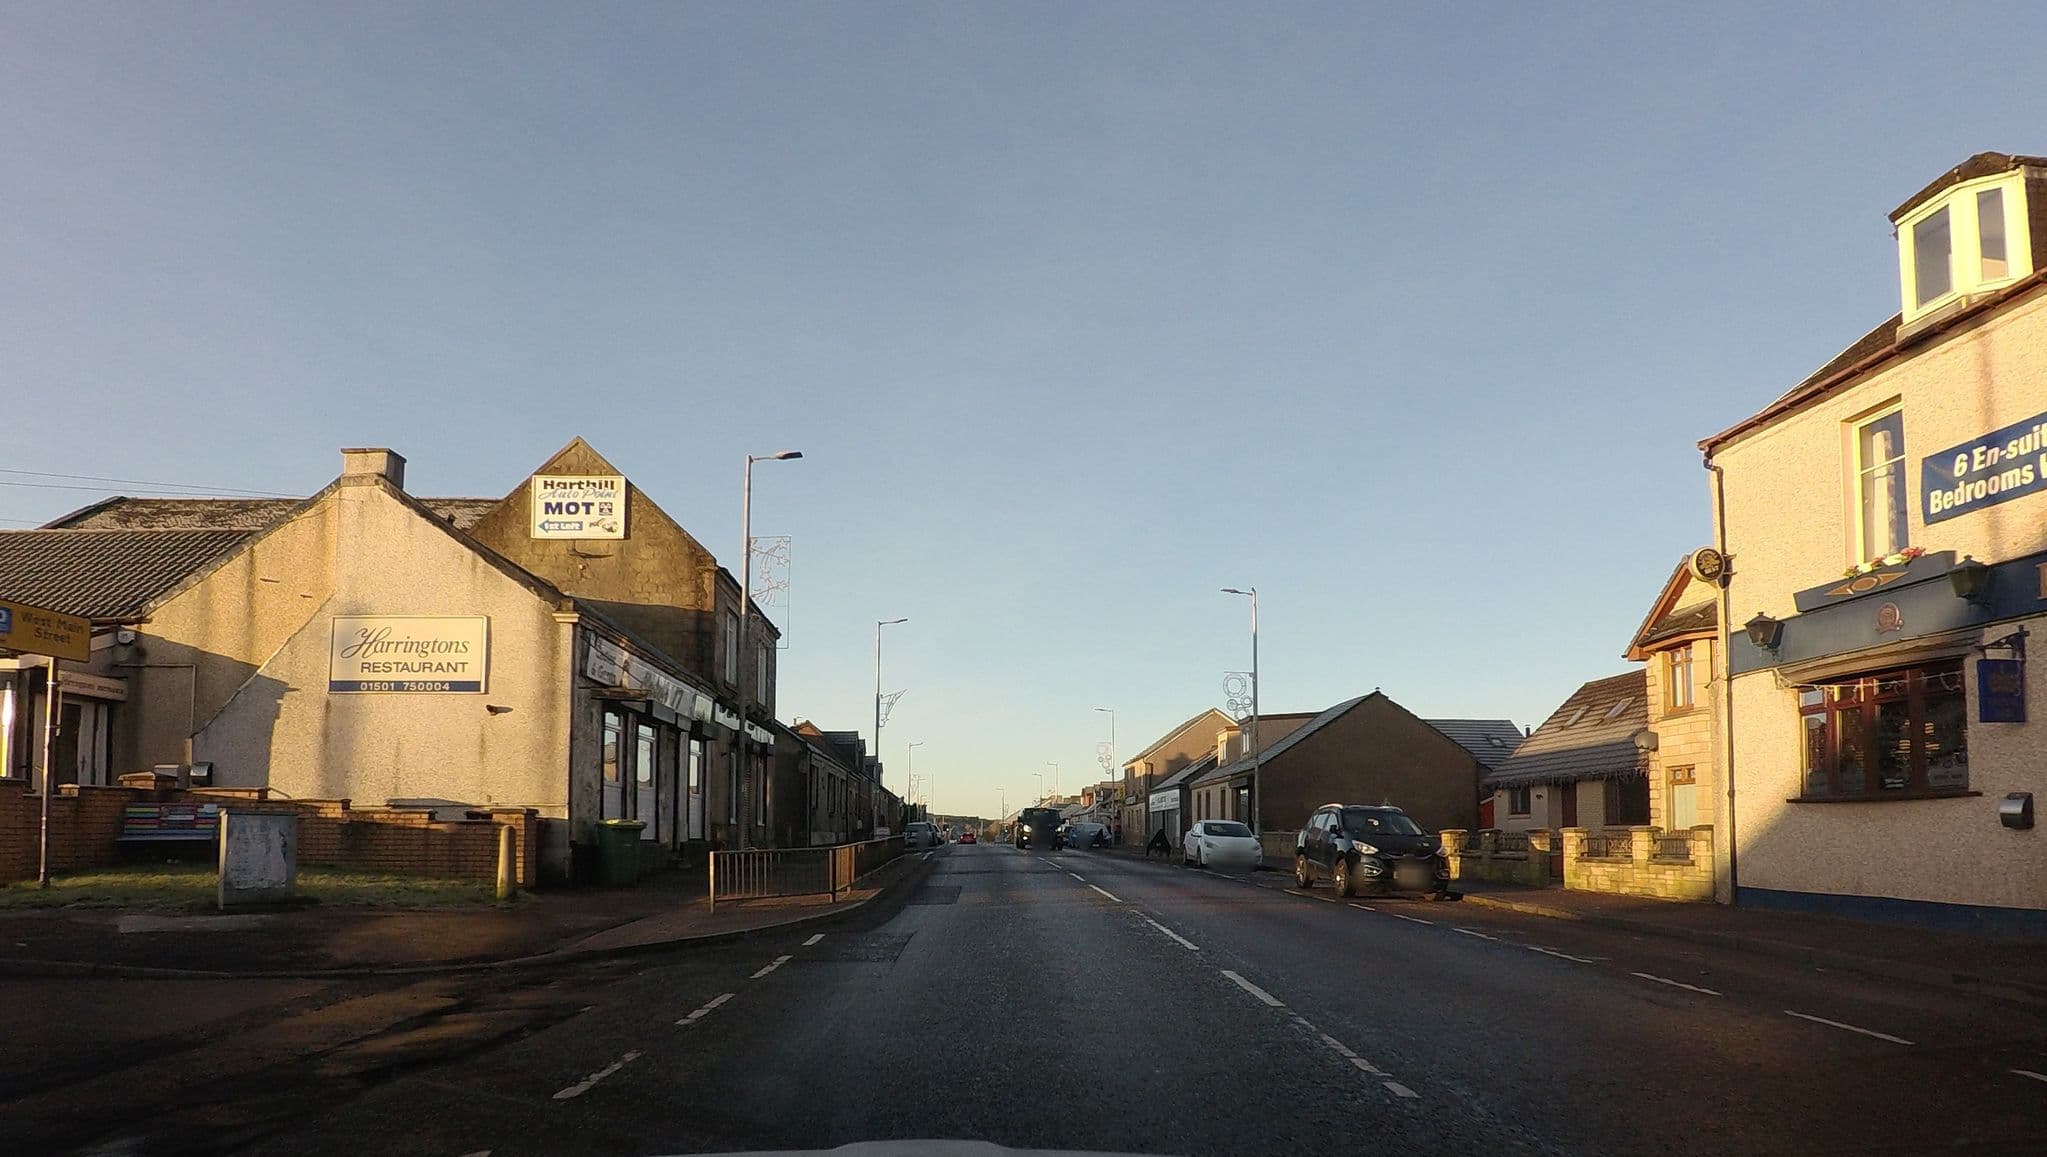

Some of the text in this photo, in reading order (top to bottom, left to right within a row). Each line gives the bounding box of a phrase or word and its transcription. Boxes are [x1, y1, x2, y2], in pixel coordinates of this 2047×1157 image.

[1954, 453, 1968, 477] 6
[543, 480, 614, 490] Harthill
[1929, 464, 2035, 514] Bedrooms
[538, 487, 619, 499] Auto Point
[544, 502, 595, 515] MOT
[21, 612, 84, 634] West Main
[33, 628, 70, 644] Street
[340, 626, 470, 659] Harringtons
[360, 661, 468, 673] RESTAURANT
[360, 682, 450, 691] 01501 750004
